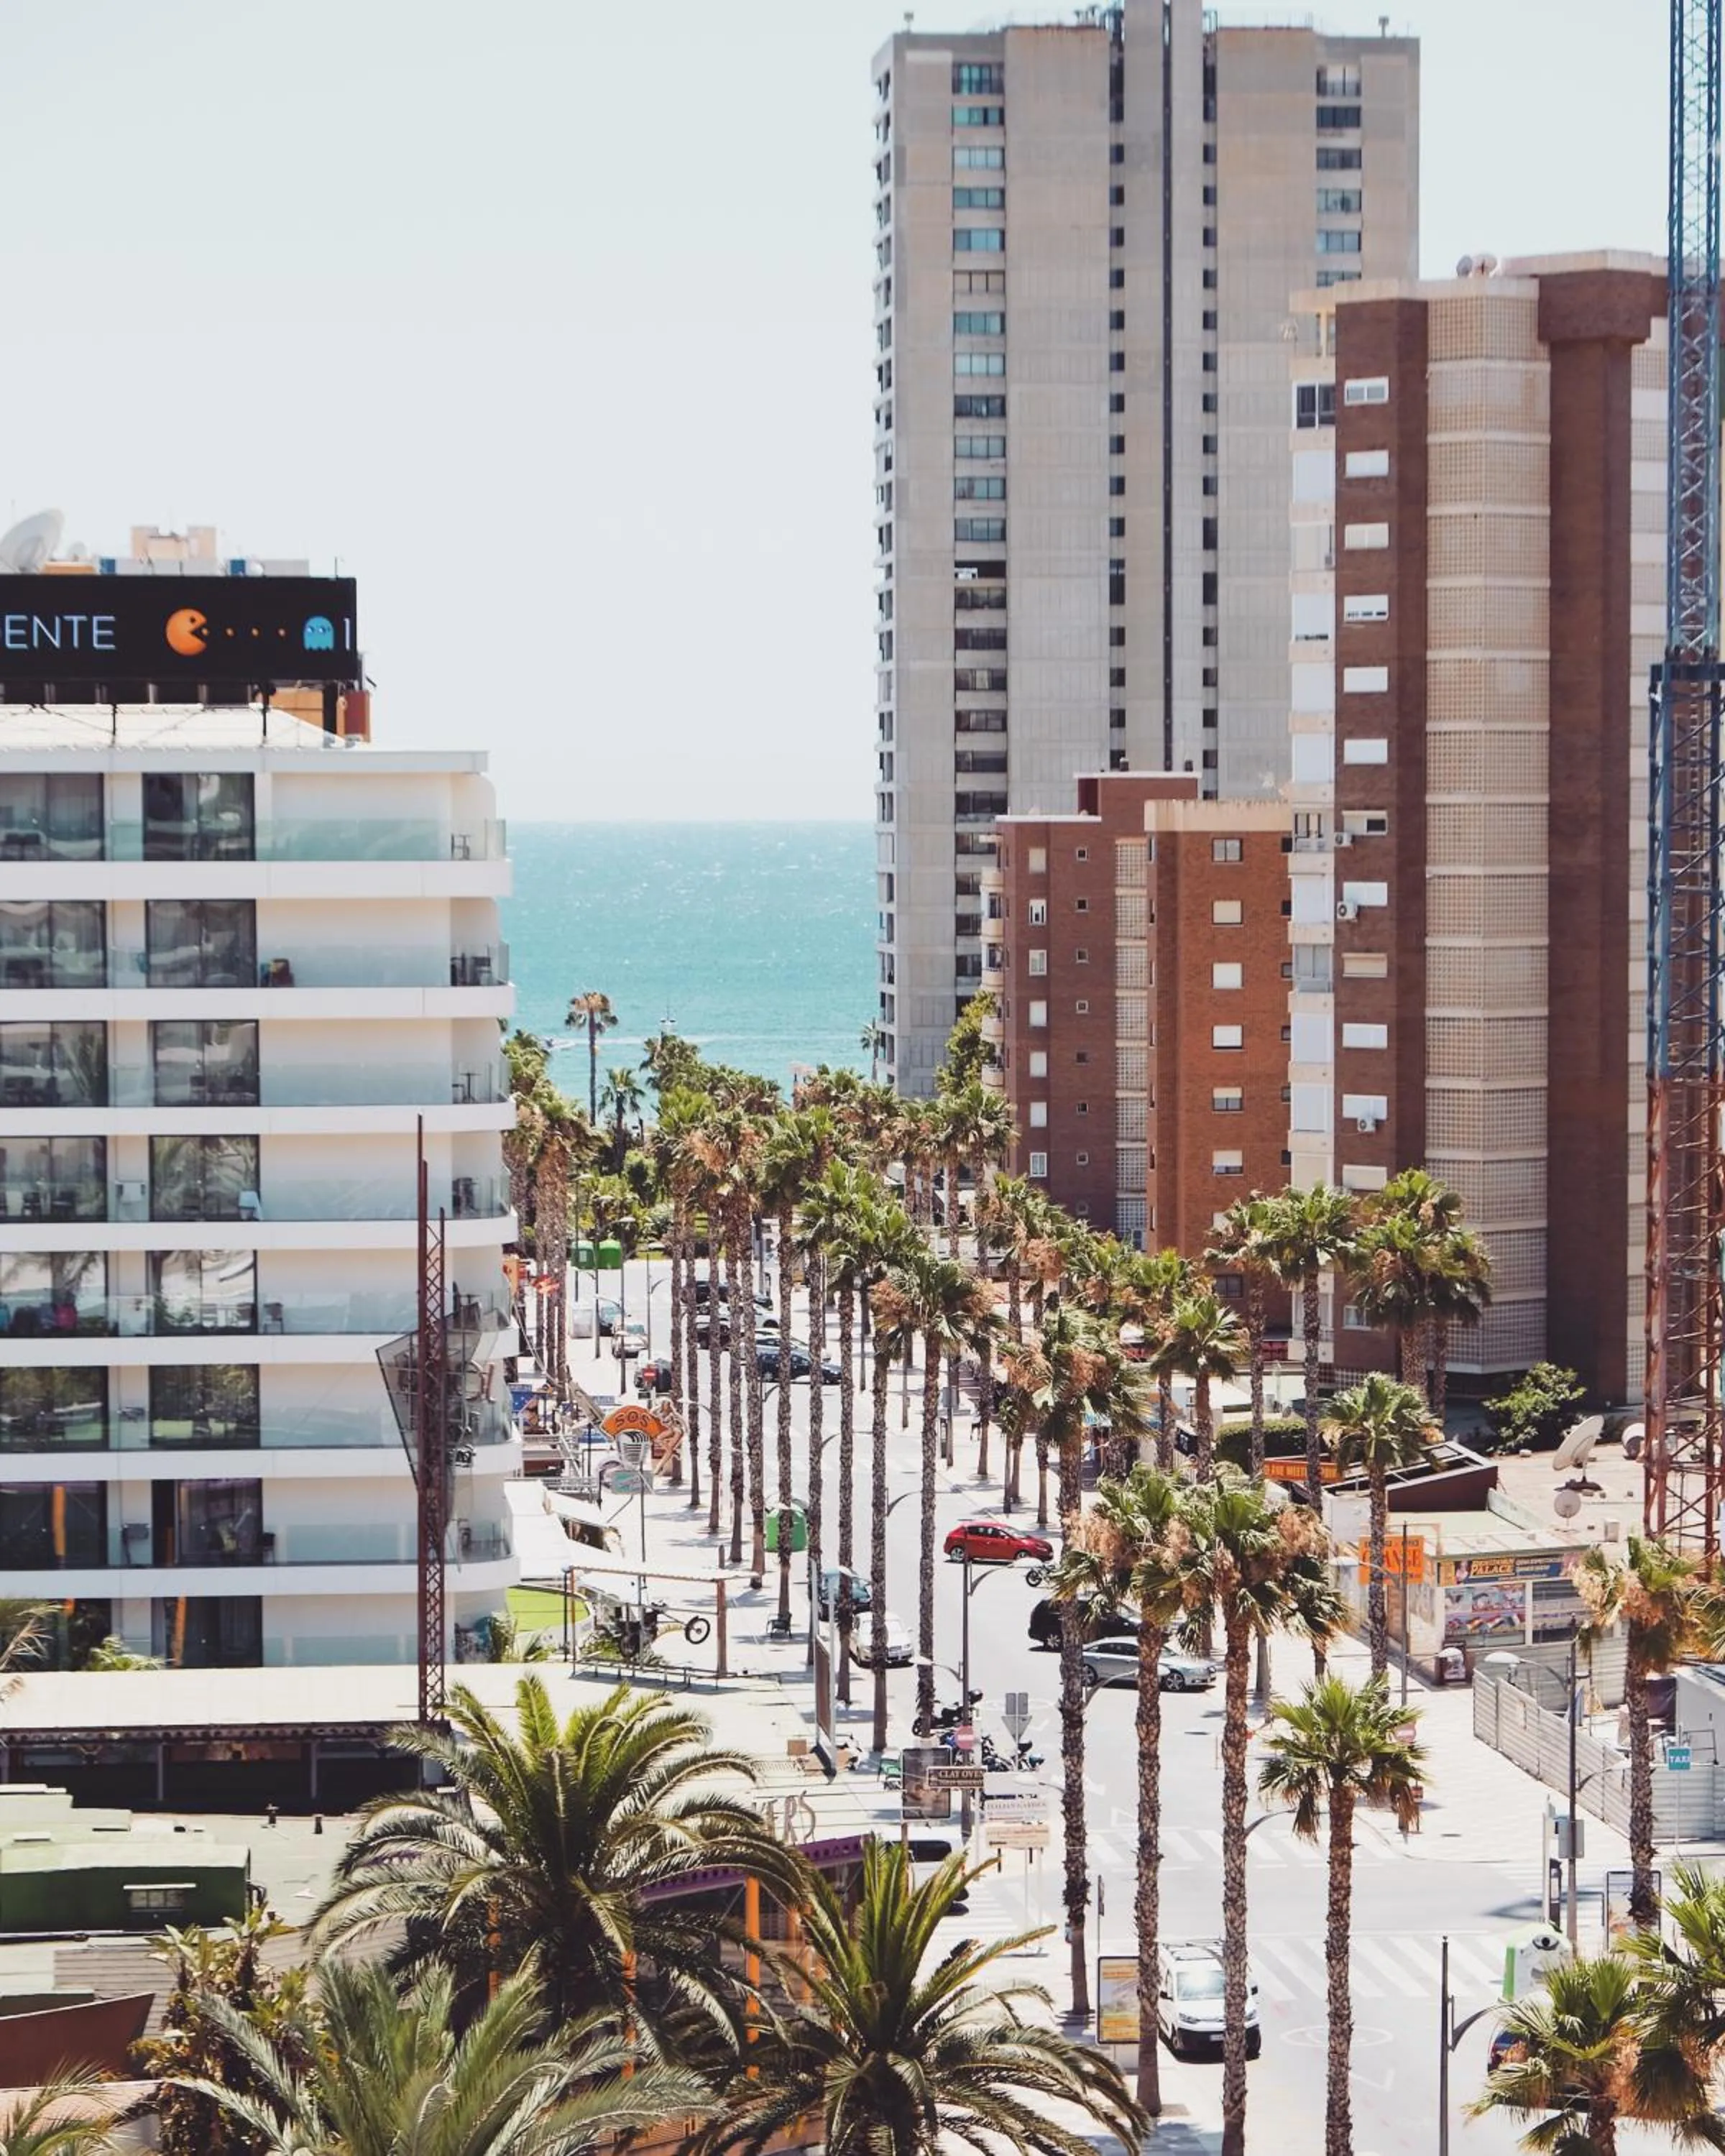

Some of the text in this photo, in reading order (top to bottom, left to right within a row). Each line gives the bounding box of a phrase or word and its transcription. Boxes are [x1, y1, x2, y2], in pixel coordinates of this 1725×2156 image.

[0, 614, 116, 650] ENTE
[615, 1411, 649, 1427] SOS
[1471, 1564, 1514, 1575] PALACE
[939, 1770, 960, 1779] CLAY
